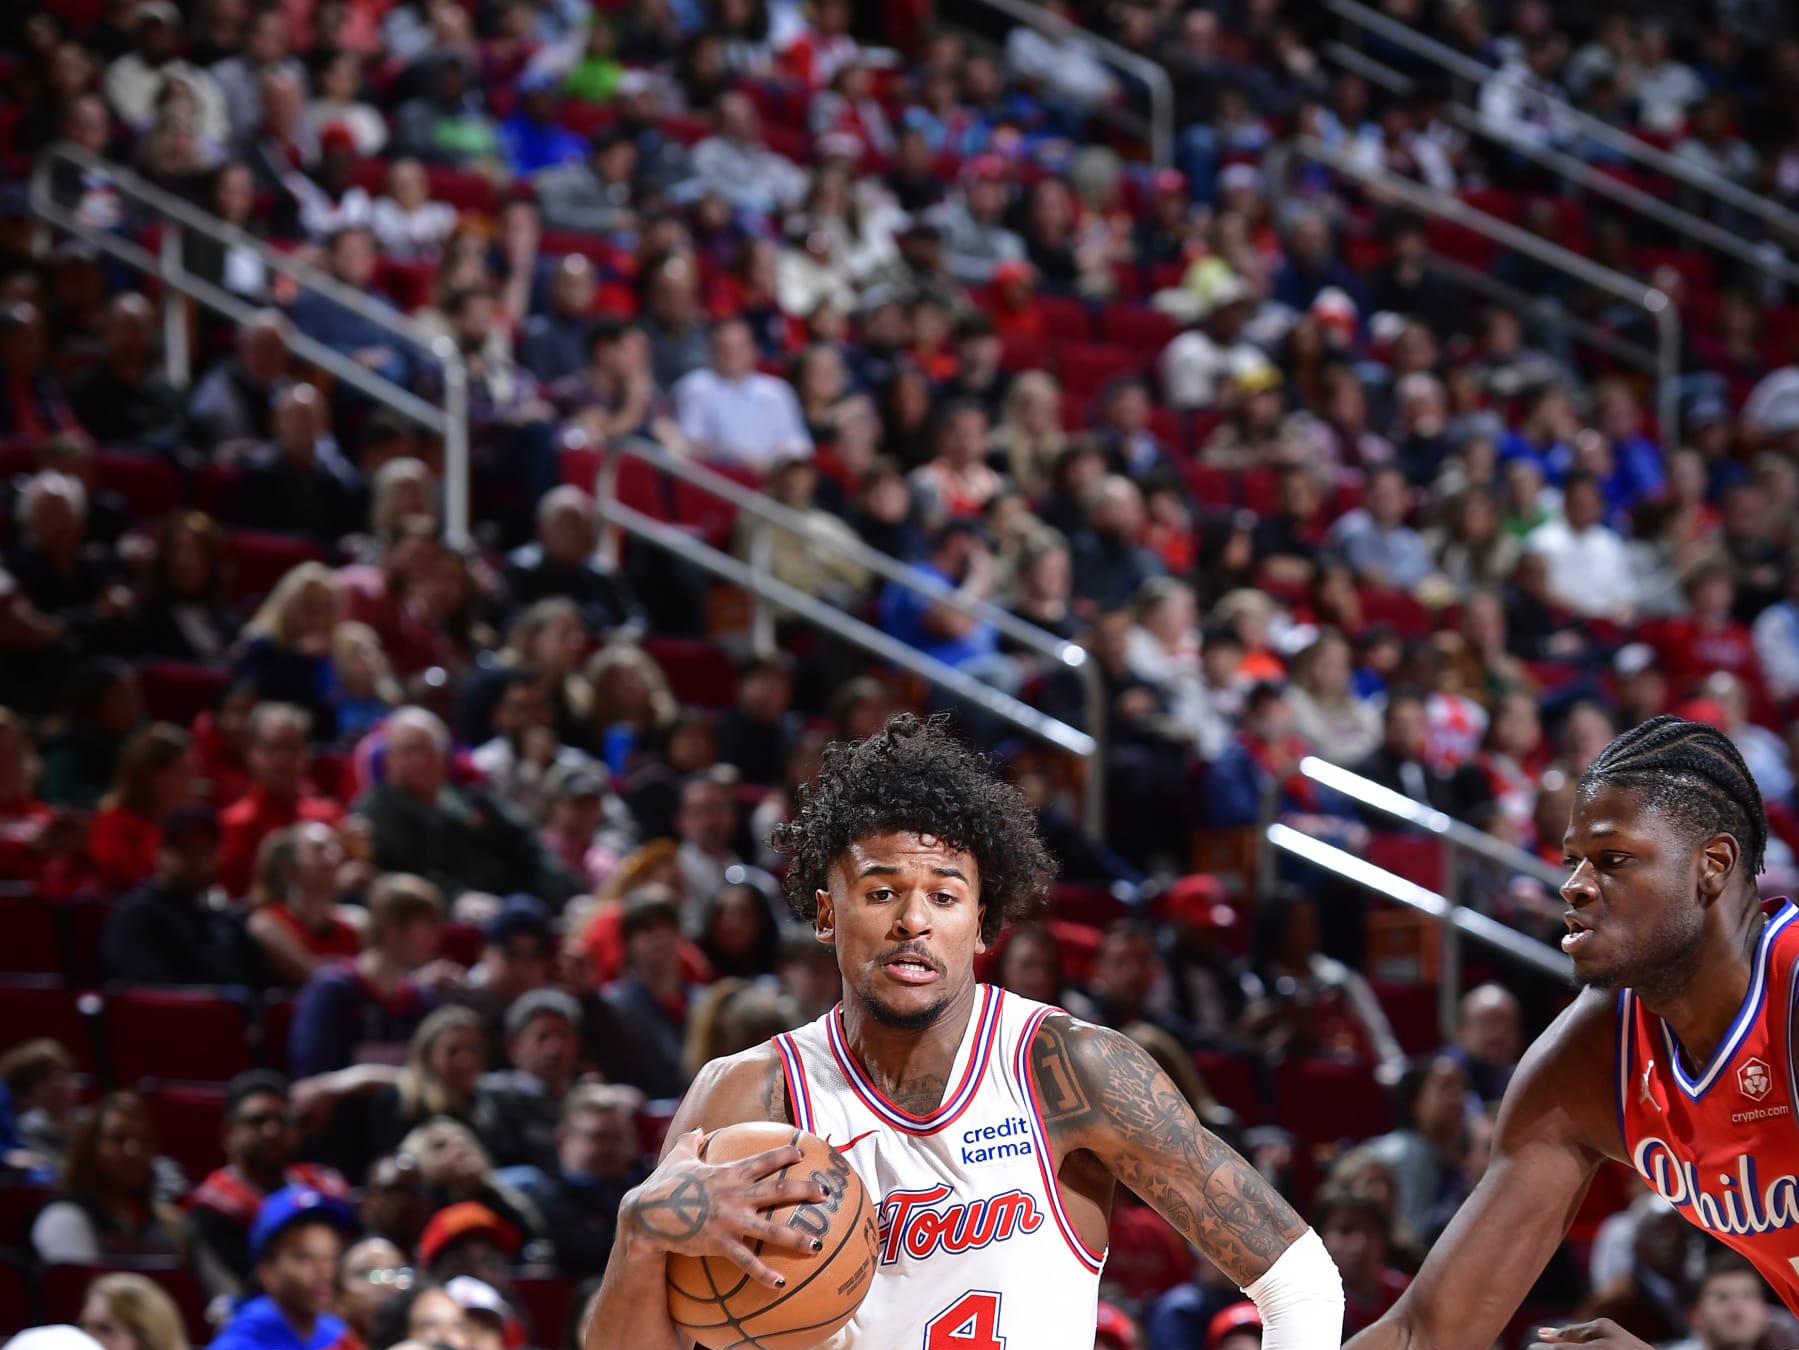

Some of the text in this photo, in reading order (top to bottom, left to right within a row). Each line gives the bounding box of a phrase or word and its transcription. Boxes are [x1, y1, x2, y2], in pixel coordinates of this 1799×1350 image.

[1731, 1104, 1790, 1124] crypto.com
[962, 1117, 1028, 1145] credit
[961, 1140, 1032, 1165] karma
[1634, 1137, 1799, 1236] Phila
